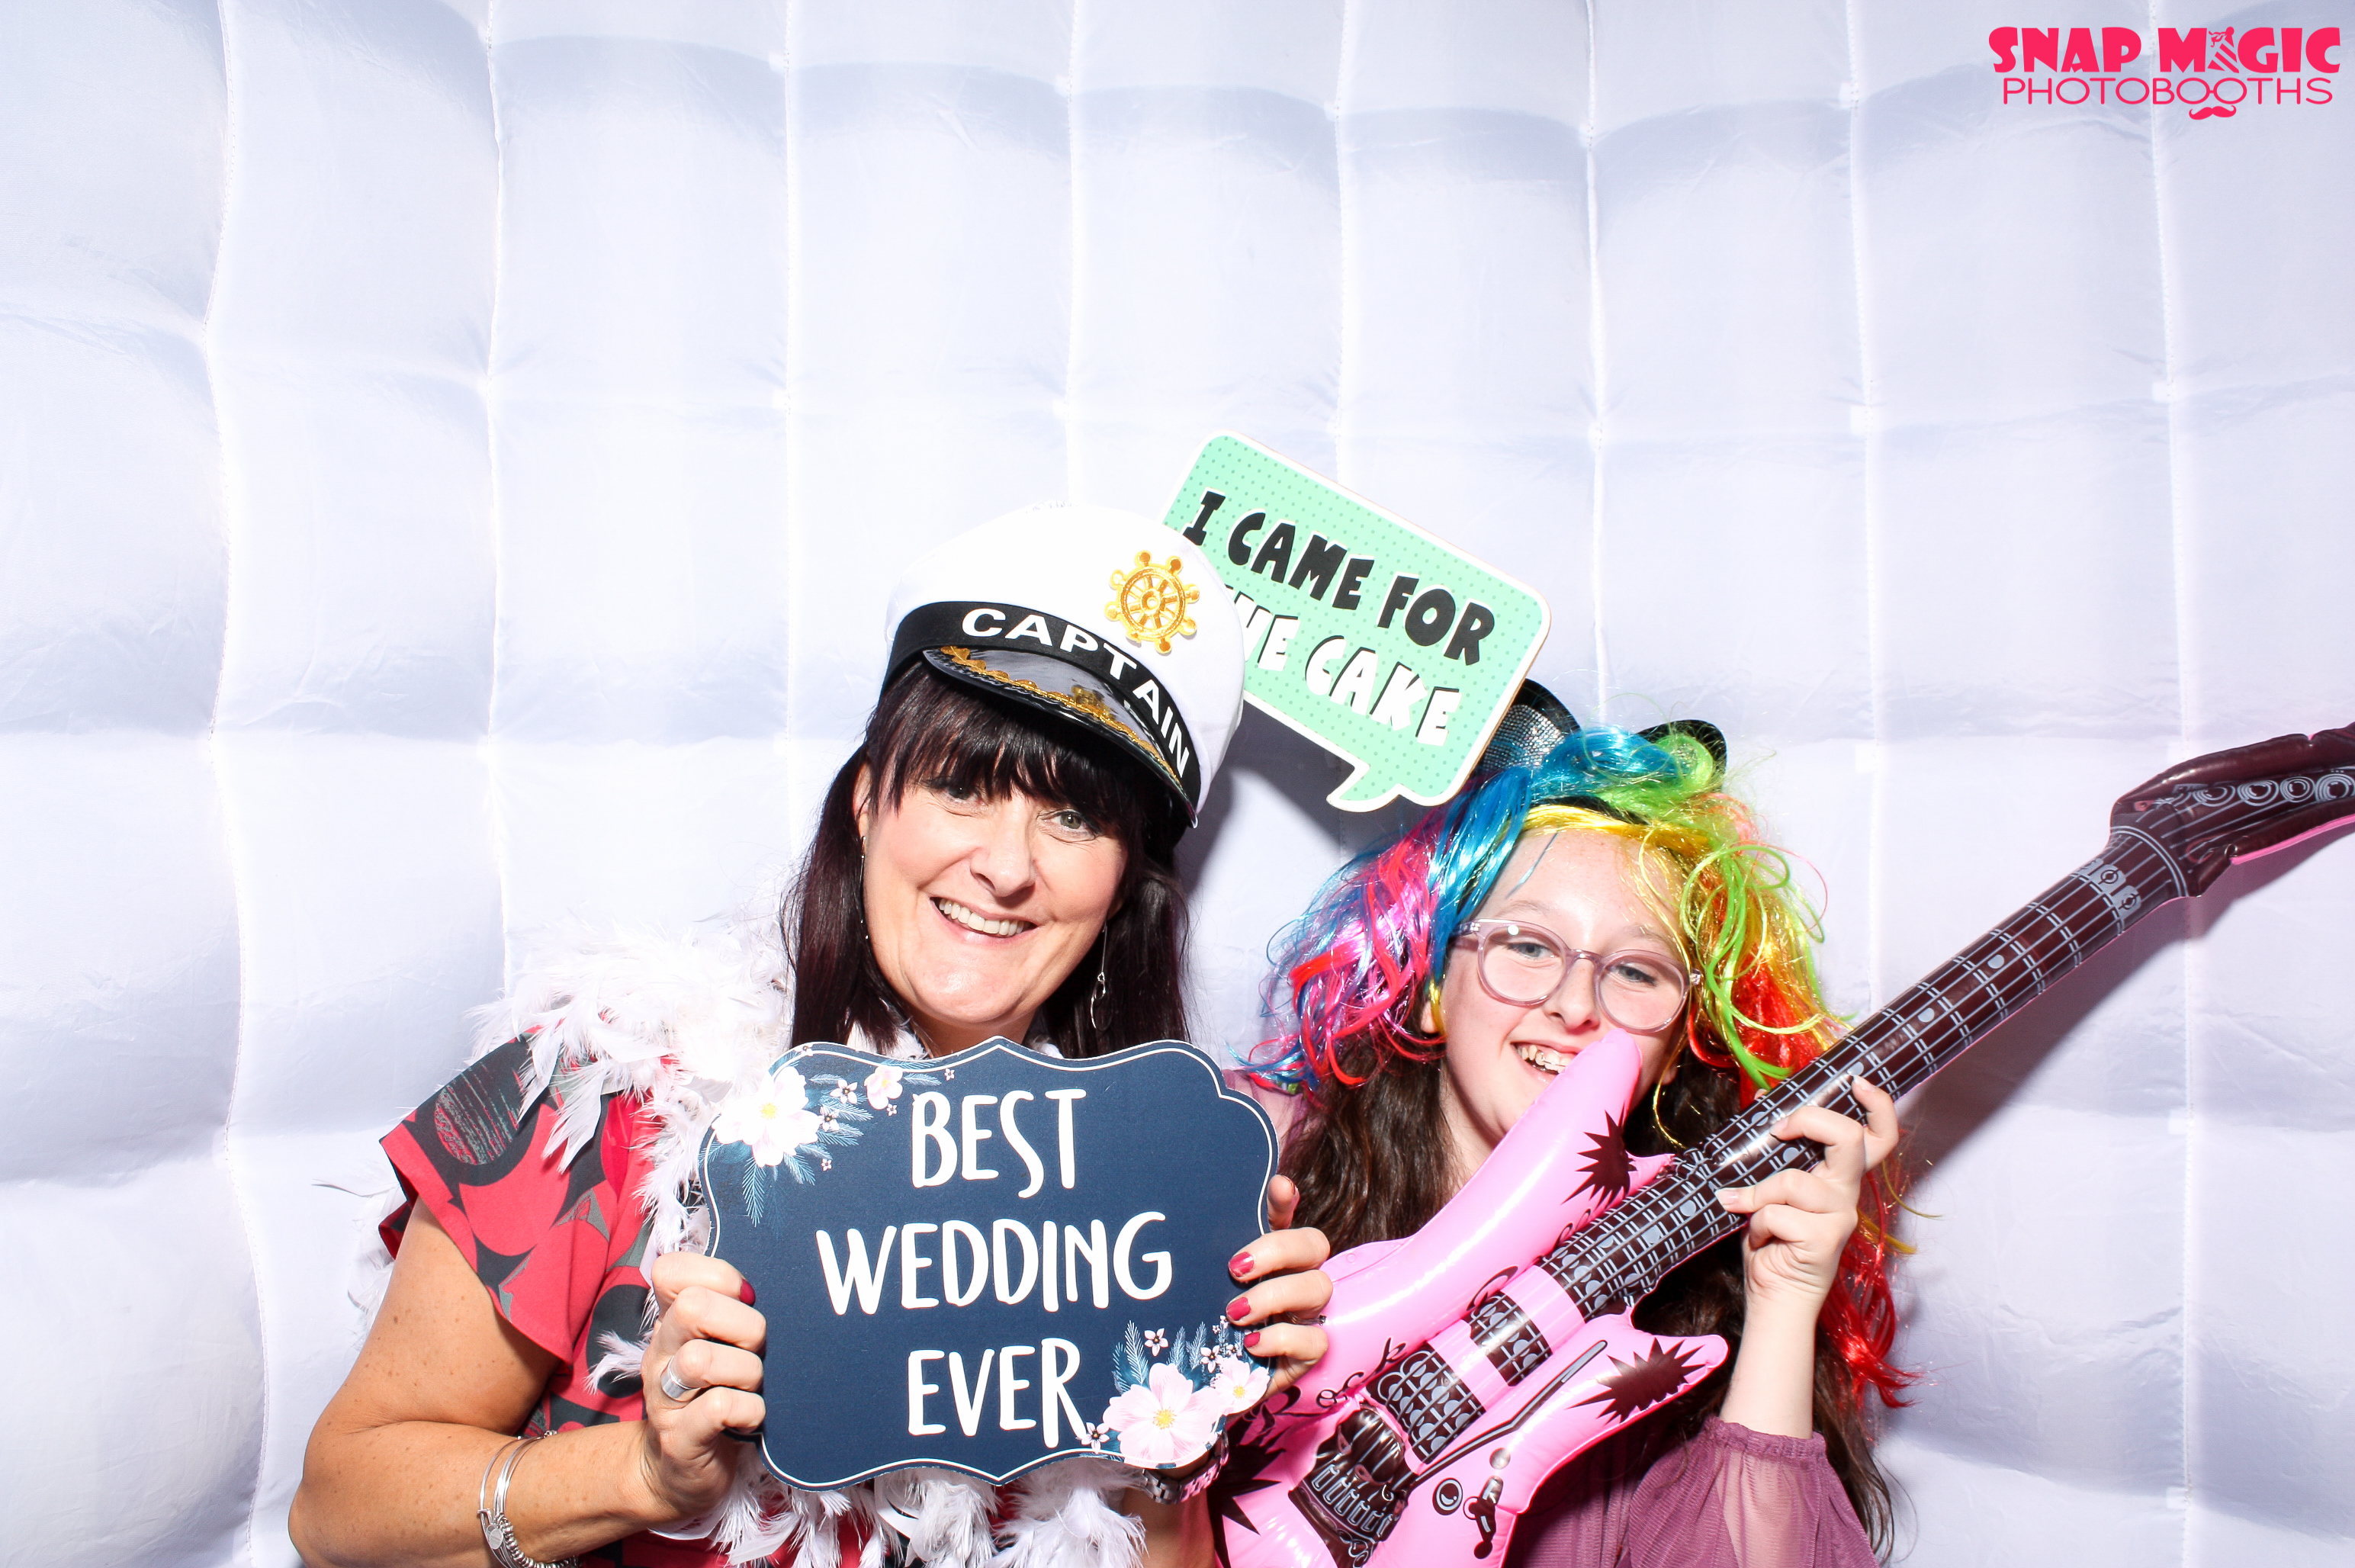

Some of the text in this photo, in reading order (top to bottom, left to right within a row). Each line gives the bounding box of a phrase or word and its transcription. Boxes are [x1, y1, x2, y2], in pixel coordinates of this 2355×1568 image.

[1183, 487, 1496, 666] I CAME FOR
[962, 608, 1190, 778] CAPTAIN
[1225, 583, 1462, 747] HE CAKE
[911, 1088, 1087, 1199] BEST
[816, 1211, 1173, 1316] WEDDING
[908, 1337, 1088, 1448] EVER
